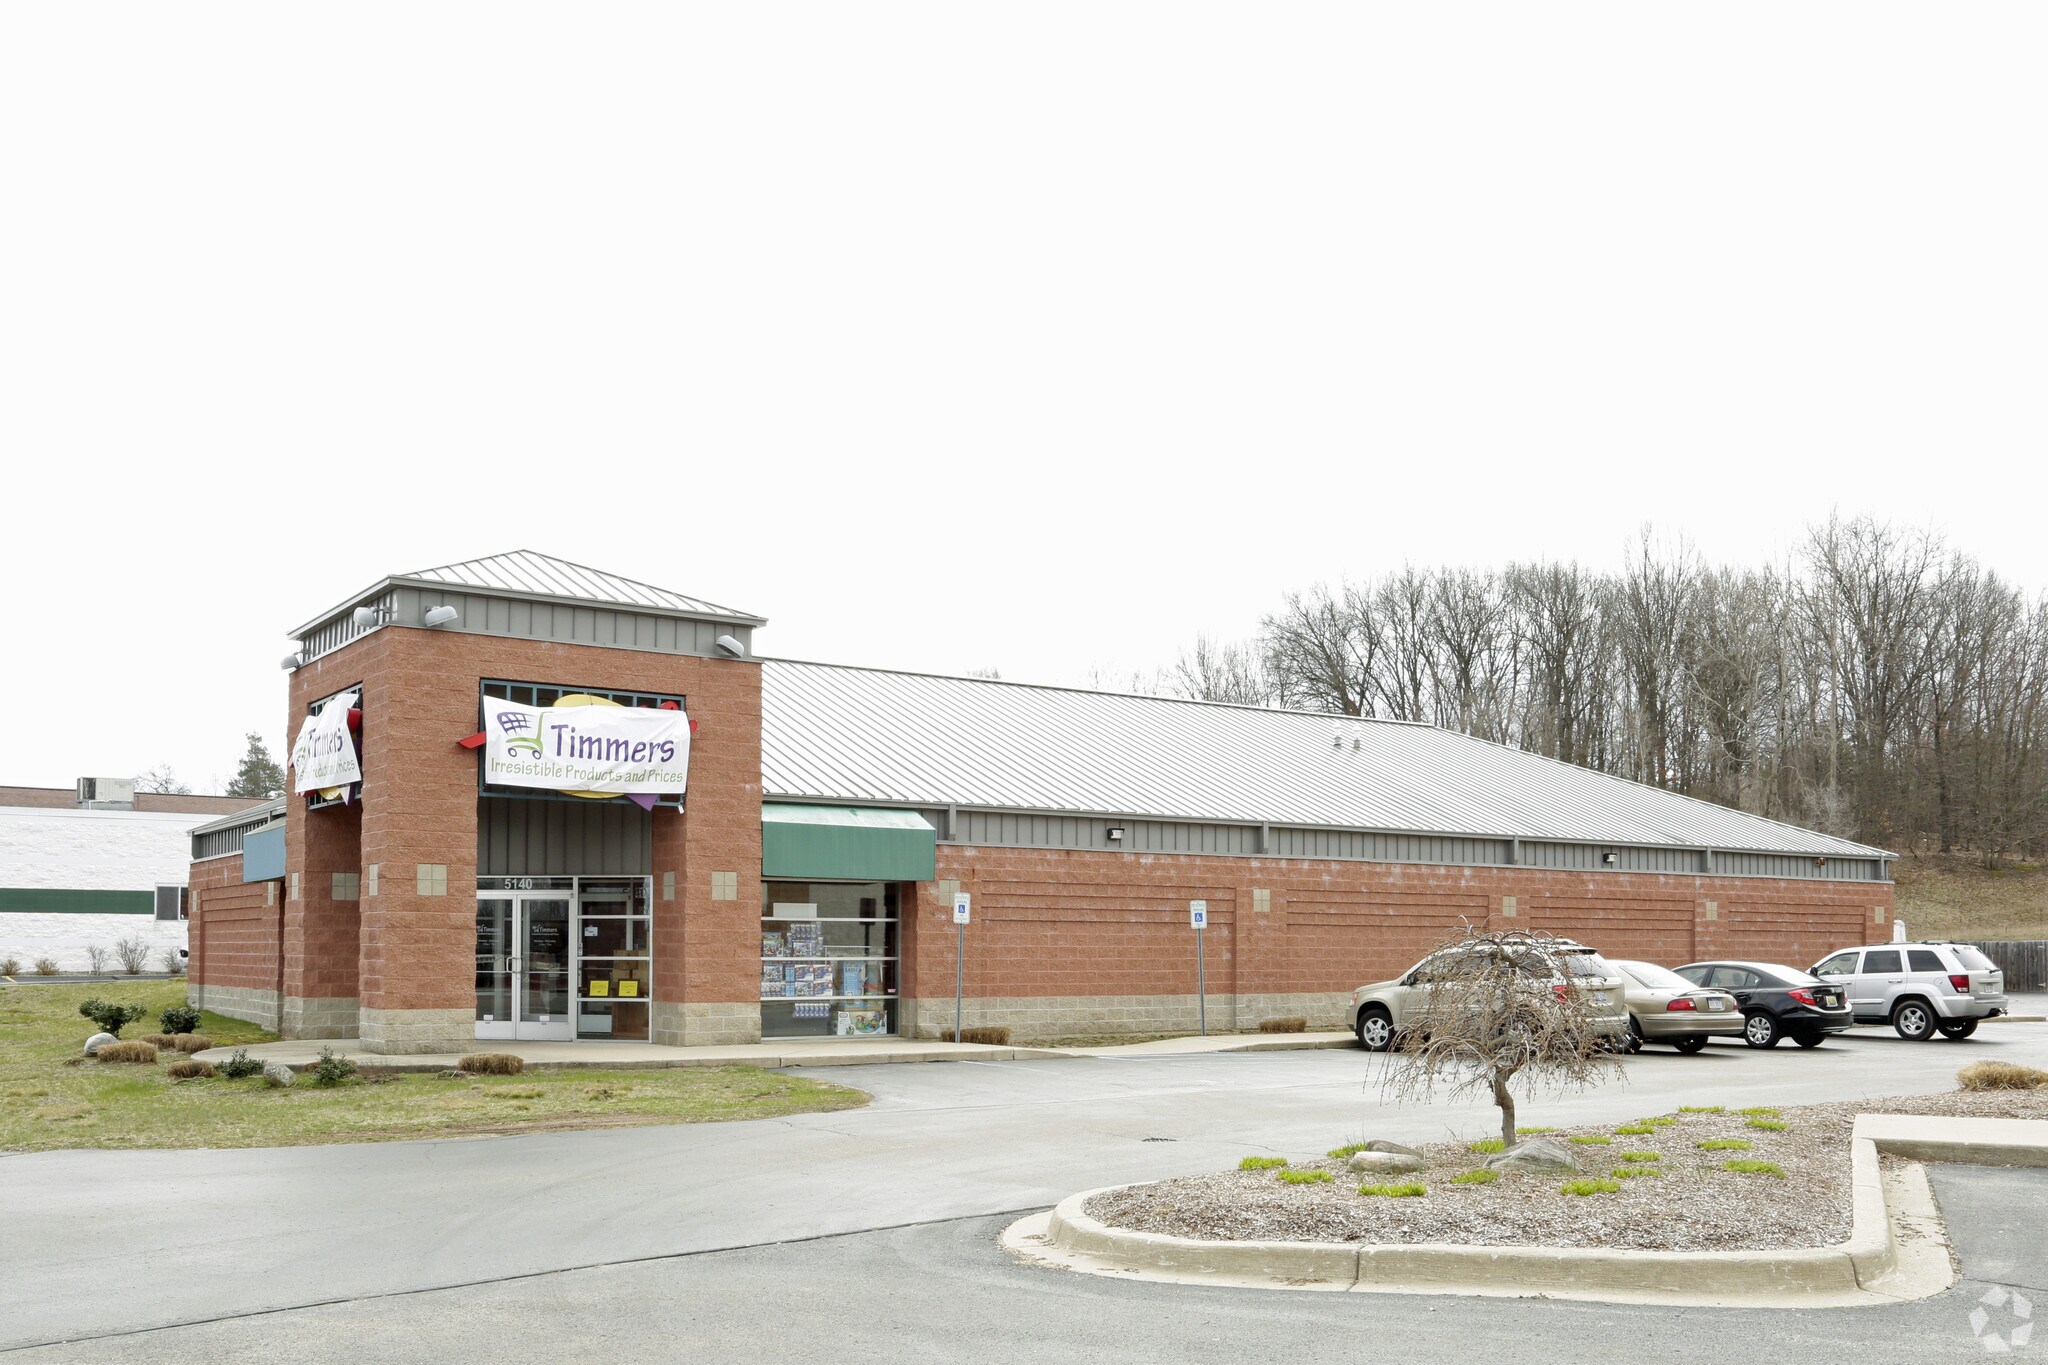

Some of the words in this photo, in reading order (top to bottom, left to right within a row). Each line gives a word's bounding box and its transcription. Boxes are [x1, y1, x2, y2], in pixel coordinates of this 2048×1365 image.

[550, 724, 674, 763] Timmers
[491, 757, 562, 778] Irresistible
[565, 764, 622, 782] Products
[624, 769, 647, 782] and
[647, 769, 683, 782] Prices
[504, 878, 532, 890] 5140
